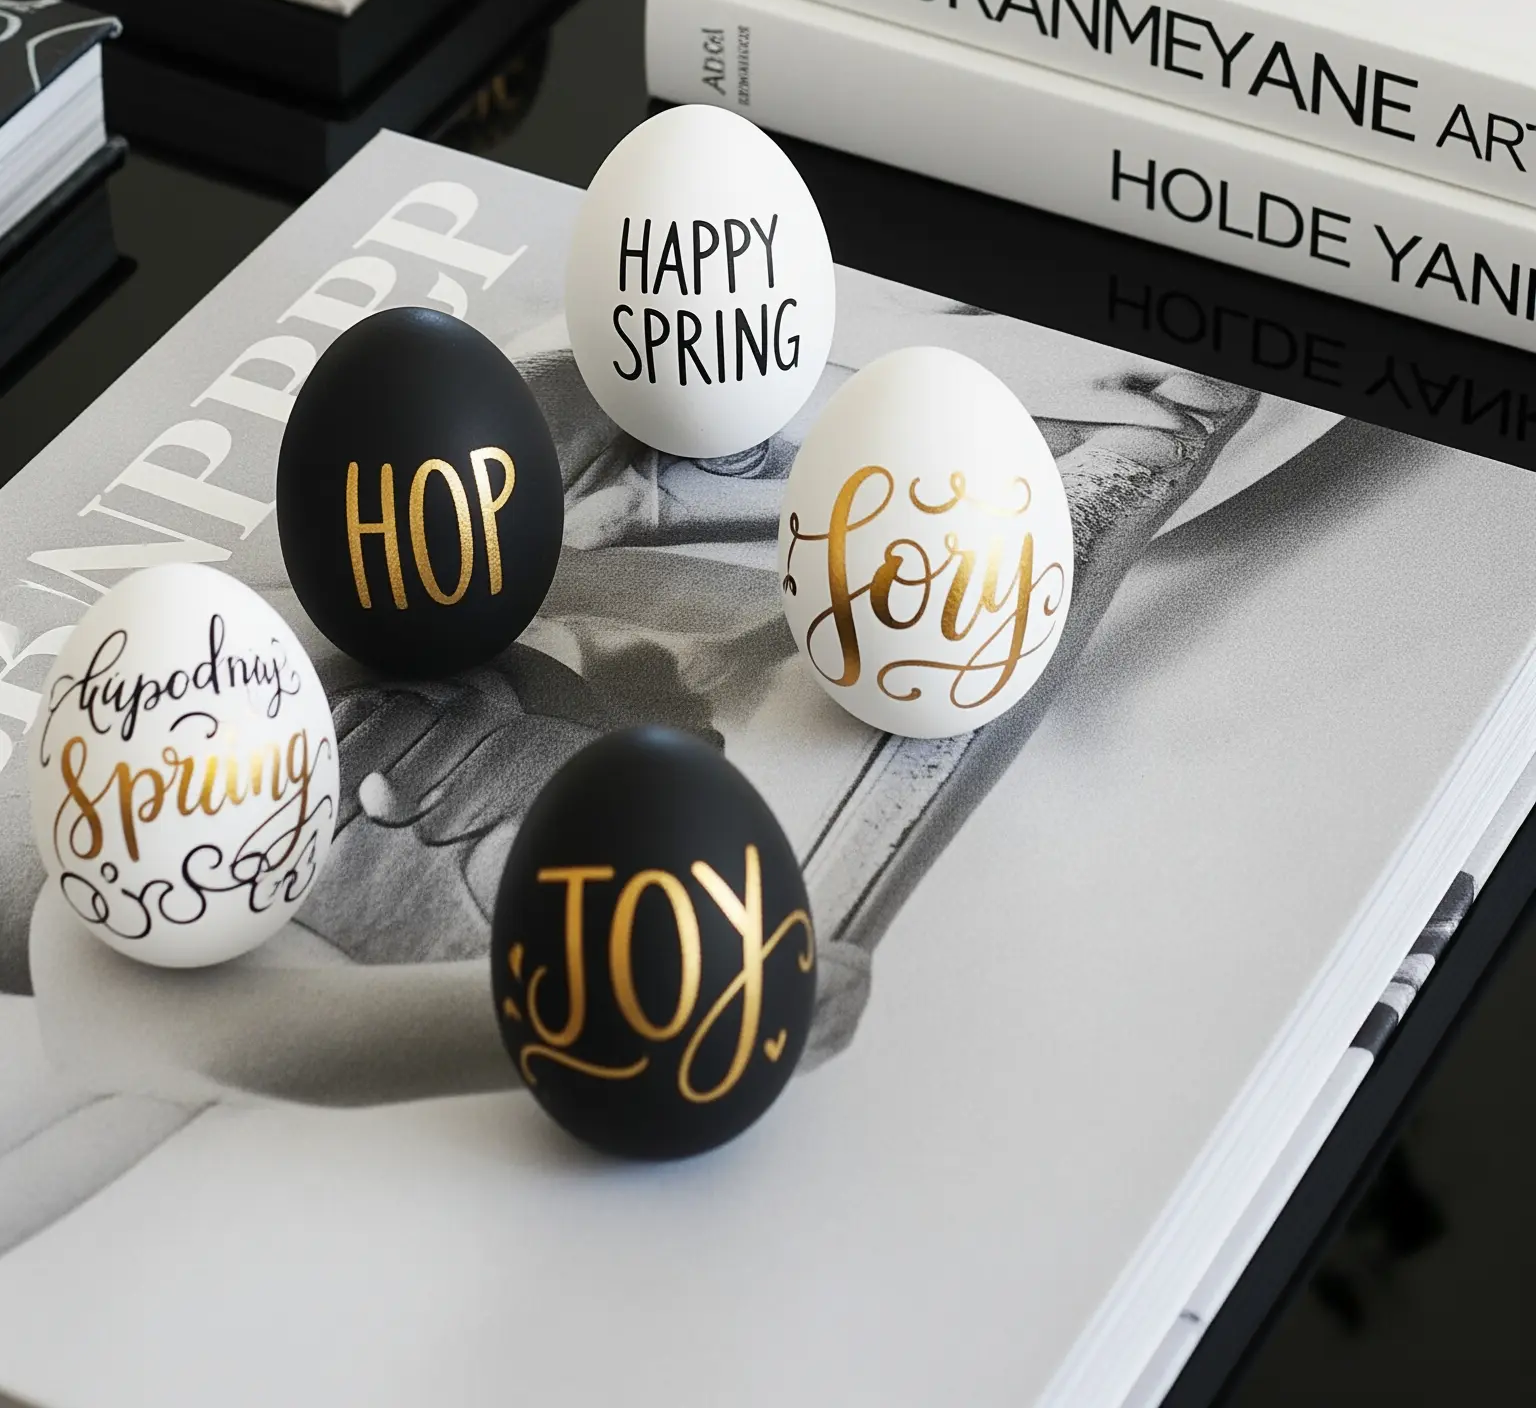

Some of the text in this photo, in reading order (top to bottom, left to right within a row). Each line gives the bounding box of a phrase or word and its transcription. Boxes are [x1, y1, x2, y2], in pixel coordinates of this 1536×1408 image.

[619, 213, 779, 296] HAPPY
[1111, 148, 1352, 268] HOLDE
[612, 298, 800, 386] SPRING
[346, 445, 516, 610] HOP
[527, 843, 815, 1103] JOY
